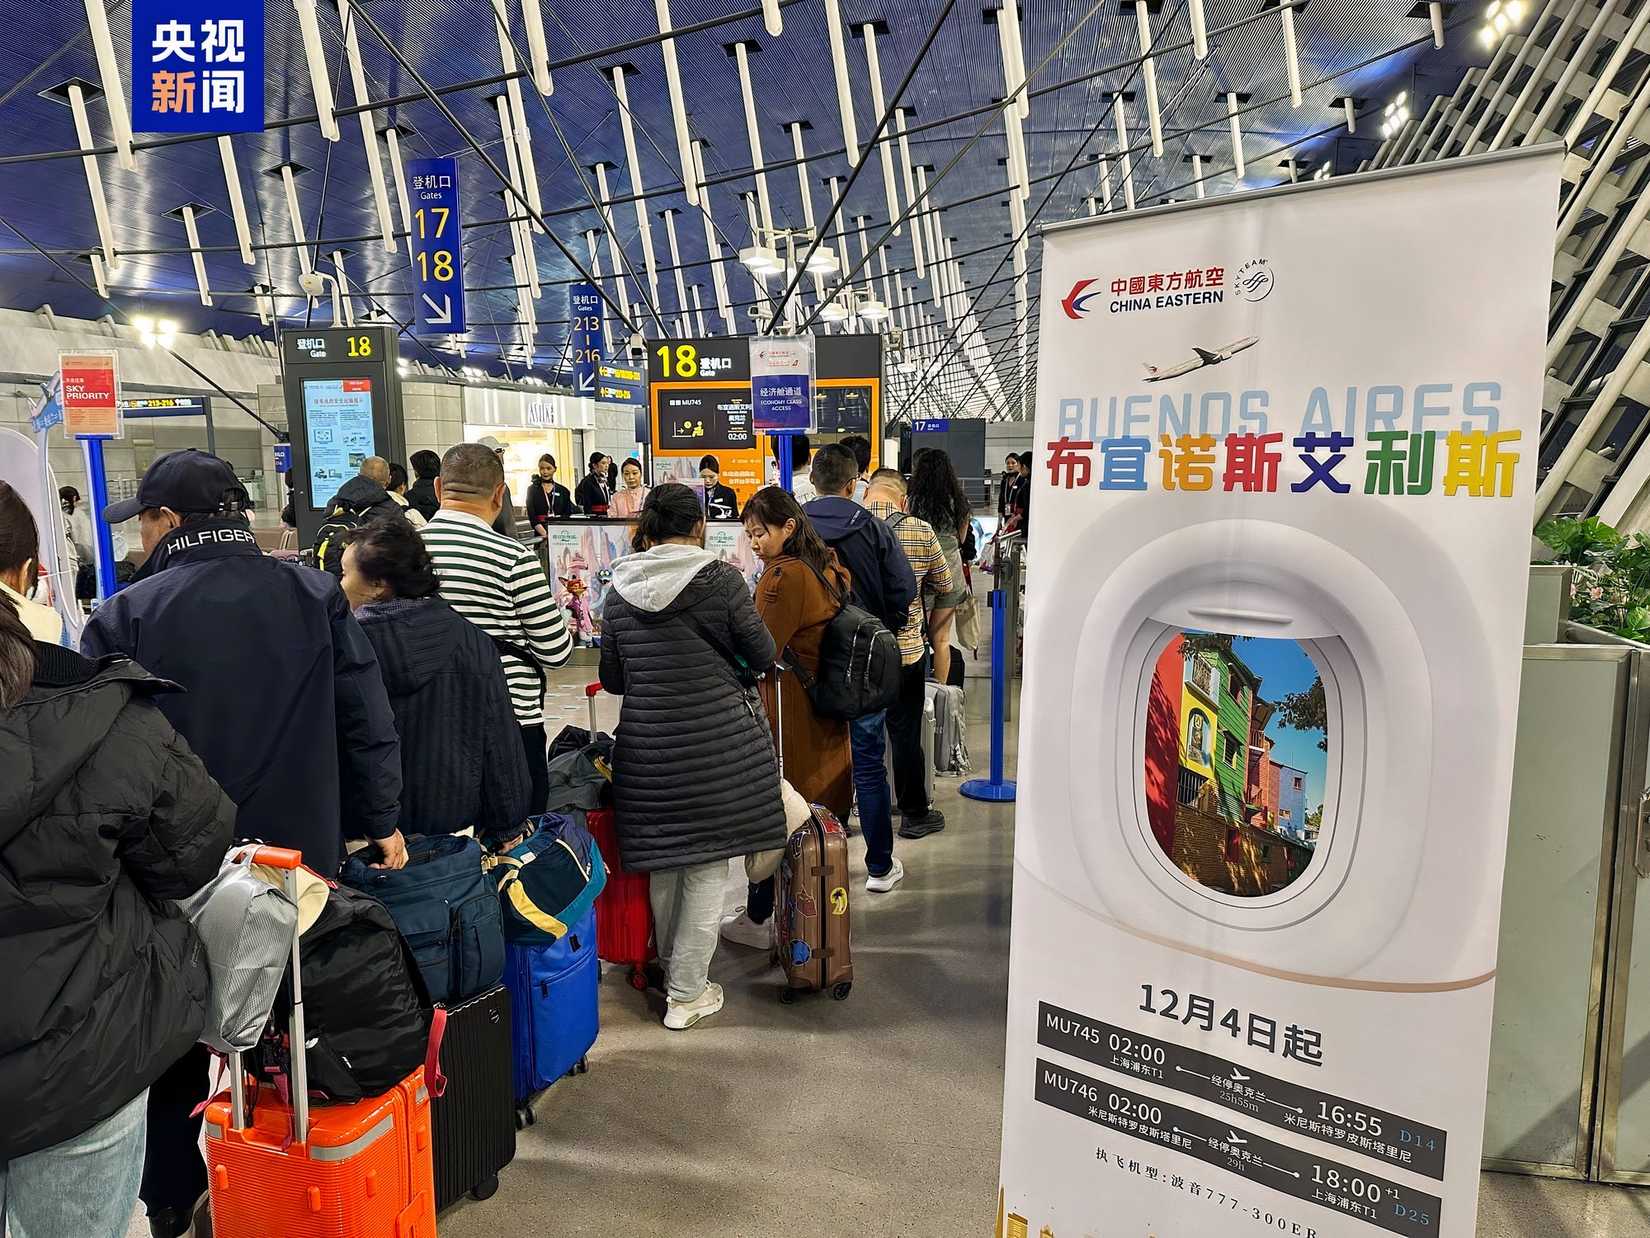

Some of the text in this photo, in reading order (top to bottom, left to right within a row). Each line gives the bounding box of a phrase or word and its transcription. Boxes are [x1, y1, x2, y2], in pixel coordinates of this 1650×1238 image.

[413, 175, 451, 190] 登机口
[420, 191, 442, 200] Gates
[415, 208, 450, 239] 17
[416, 250, 454, 282] 18
[1234, 258, 1268, 296] SKYTEAM
[1111, 266, 1225, 297] 中國東方航空
[572, 295, 598, 305] 登机口
[1110, 290, 1224, 313] CHINA EASTERN
[573, 316, 600, 331] 213
[296, 336, 372, 357] 登机口 18
[310, 349, 327, 358] Gate
[575, 349, 600, 363] 216
[656, 344, 697, 378] 18
[700, 357, 732, 370] 登机口
[700, 369, 716, 377] Gate
[65, 385, 85, 393] SKY
[66, 392, 109, 400] PRIORITY
[1057, 382, 1502, 443] BUENOS AIRES
[727, 433, 748, 441] 02:00
[914, 421, 926, 432] 17
[1046, 429, 1522, 498] 布宜诺斯艾利斯
[167, 528, 256, 555] HILFIGER
[1046, 1013, 1166, 1065] MU745 02:00
[1138, 984, 1323, 1067] 12月4日起
[1109, 1053, 1164, 1080] 上海浦东T1
[1043, 1070, 1162, 1124] MU746 02:00
[1210, 1073, 1267, 1104] 经停奥克兰
[1219, 1090, 1260, 1113] 25h55m
[1087, 1105, 1193, 1150] 米尼斯特罗皮斯塔里尼
[1283, 1112, 1412, 1163] 米尼斯特罗皮斯塔里尼
[1317, 1101, 1436, 1151] 16:55 D14
[1207, 1136, 1264, 1168] 经停奥克兰
[1226, 1156, 1246, 1172] 29h
[1311, 1165, 1400, 1203] 18:00 +1
[1311, 1188, 1377, 1220] 上海浦东T1
[1394, 1203, 1430, 1226] D25
